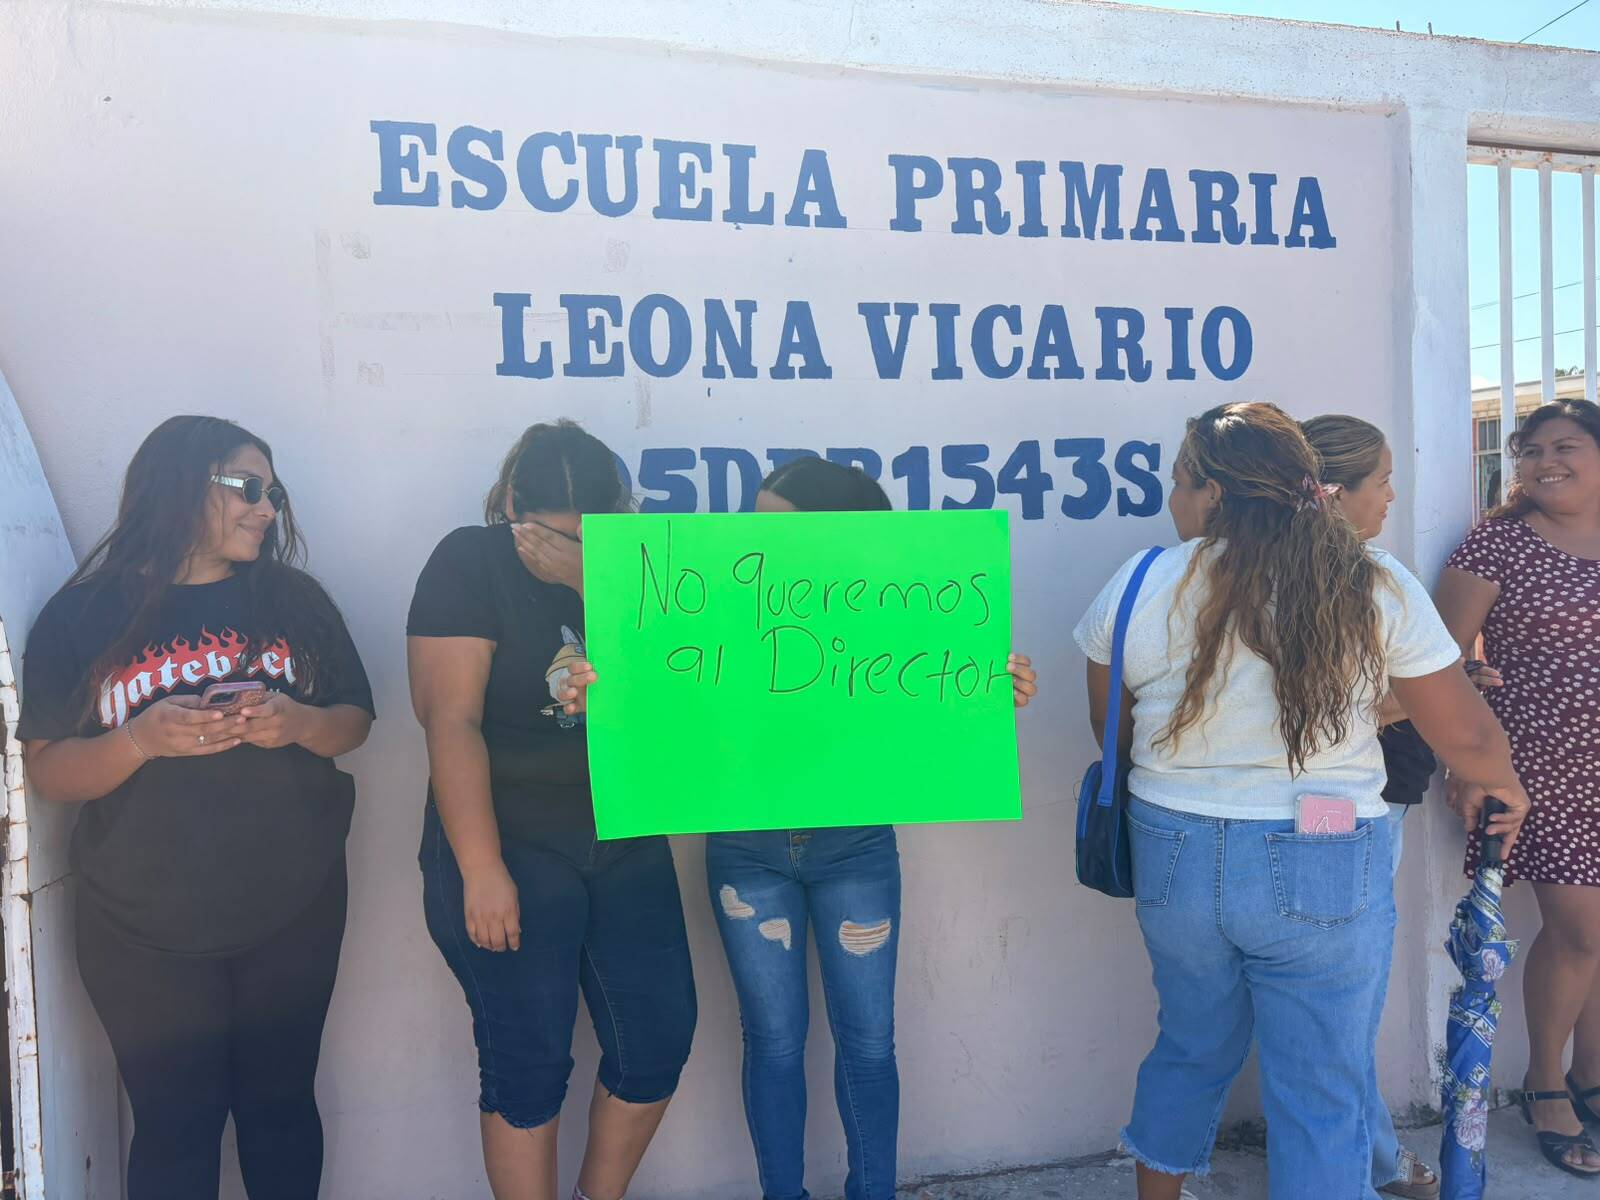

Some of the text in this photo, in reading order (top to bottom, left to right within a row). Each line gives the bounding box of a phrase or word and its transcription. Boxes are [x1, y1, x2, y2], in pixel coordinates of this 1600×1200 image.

[370, 120, 1337, 249] ESCUELA PRIMARIA
[494, 292, 1253, 382] LEONA VICARIO
[613, 438, 1163, 520] 5D1543S
[637, 520, 990, 630] No queremos
[666, 625, 1012, 703] al Director
